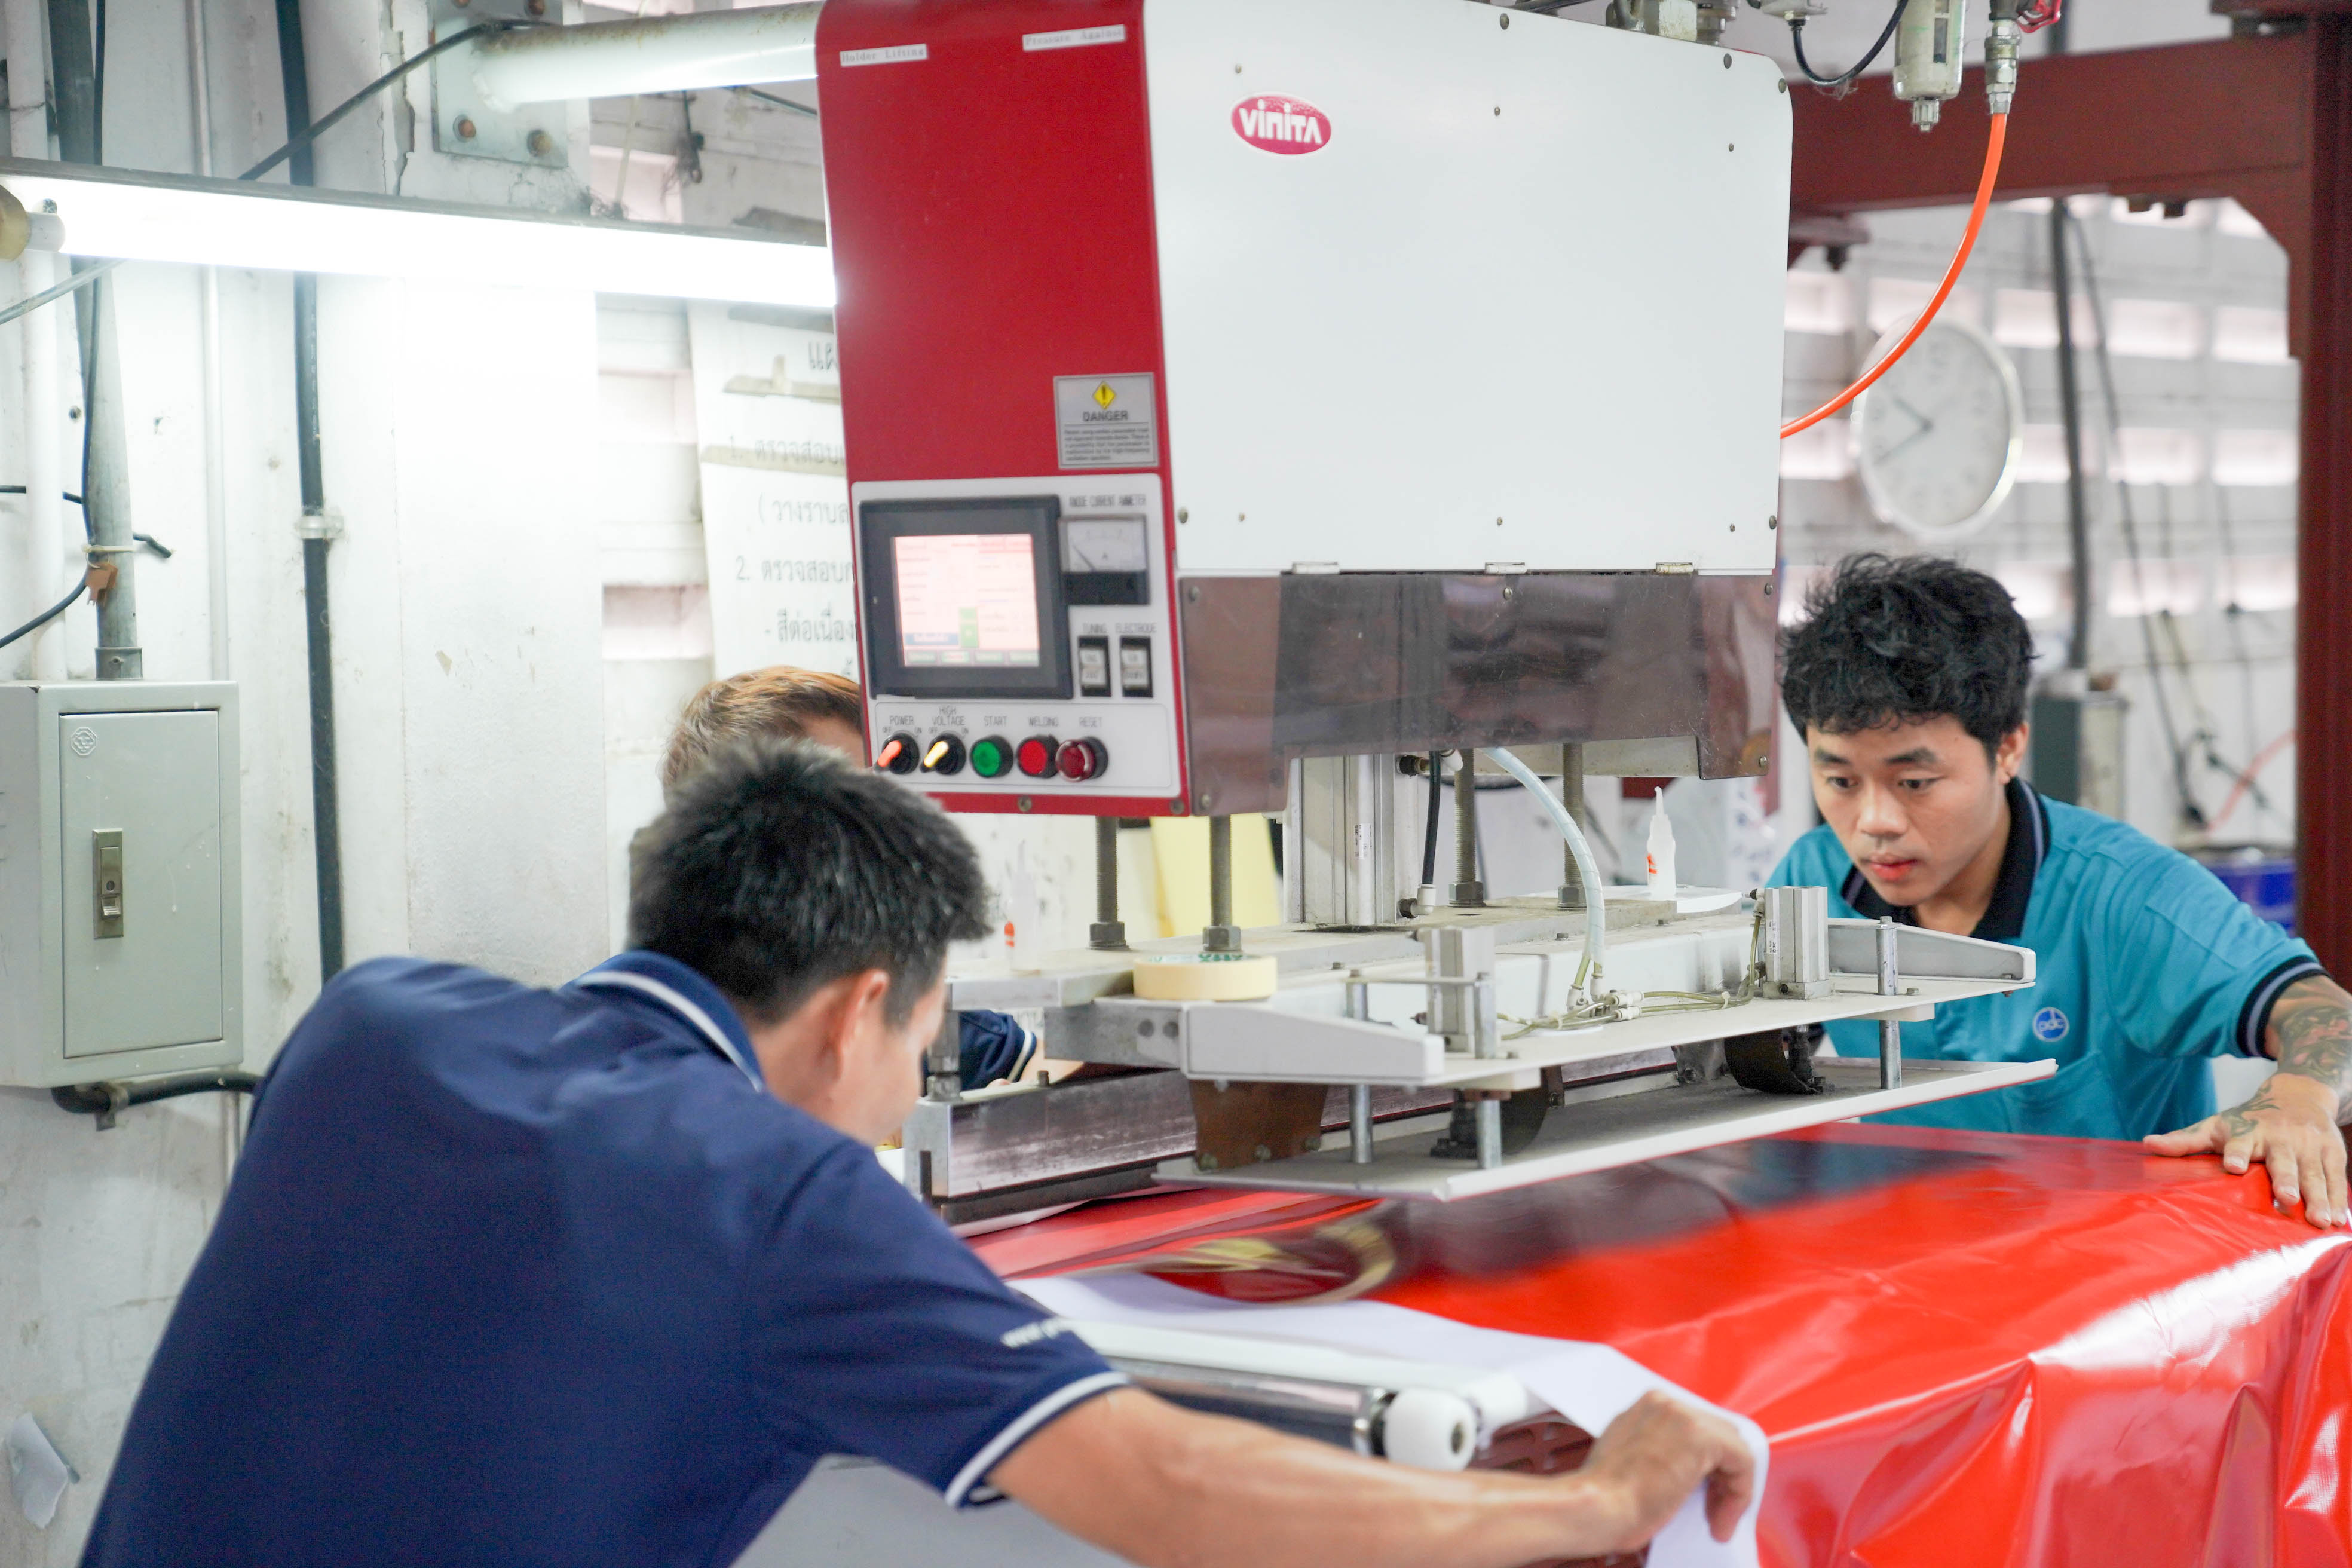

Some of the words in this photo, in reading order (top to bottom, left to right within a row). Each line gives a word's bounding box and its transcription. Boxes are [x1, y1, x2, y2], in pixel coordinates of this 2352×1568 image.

[842, 51, 876, 63] Holder
[1082, 410, 1129, 421] DANGER
[736, 554, 751, 581] 2.
[939, 706, 957, 715] HIGH
[889, 715, 914, 725] POWER
[932, 716, 965, 726] VOLTAGE
[984, 716, 1007, 726] START
[1028, 717, 1059, 727] WELDING
[1079, 717, 1102, 727] RESET
